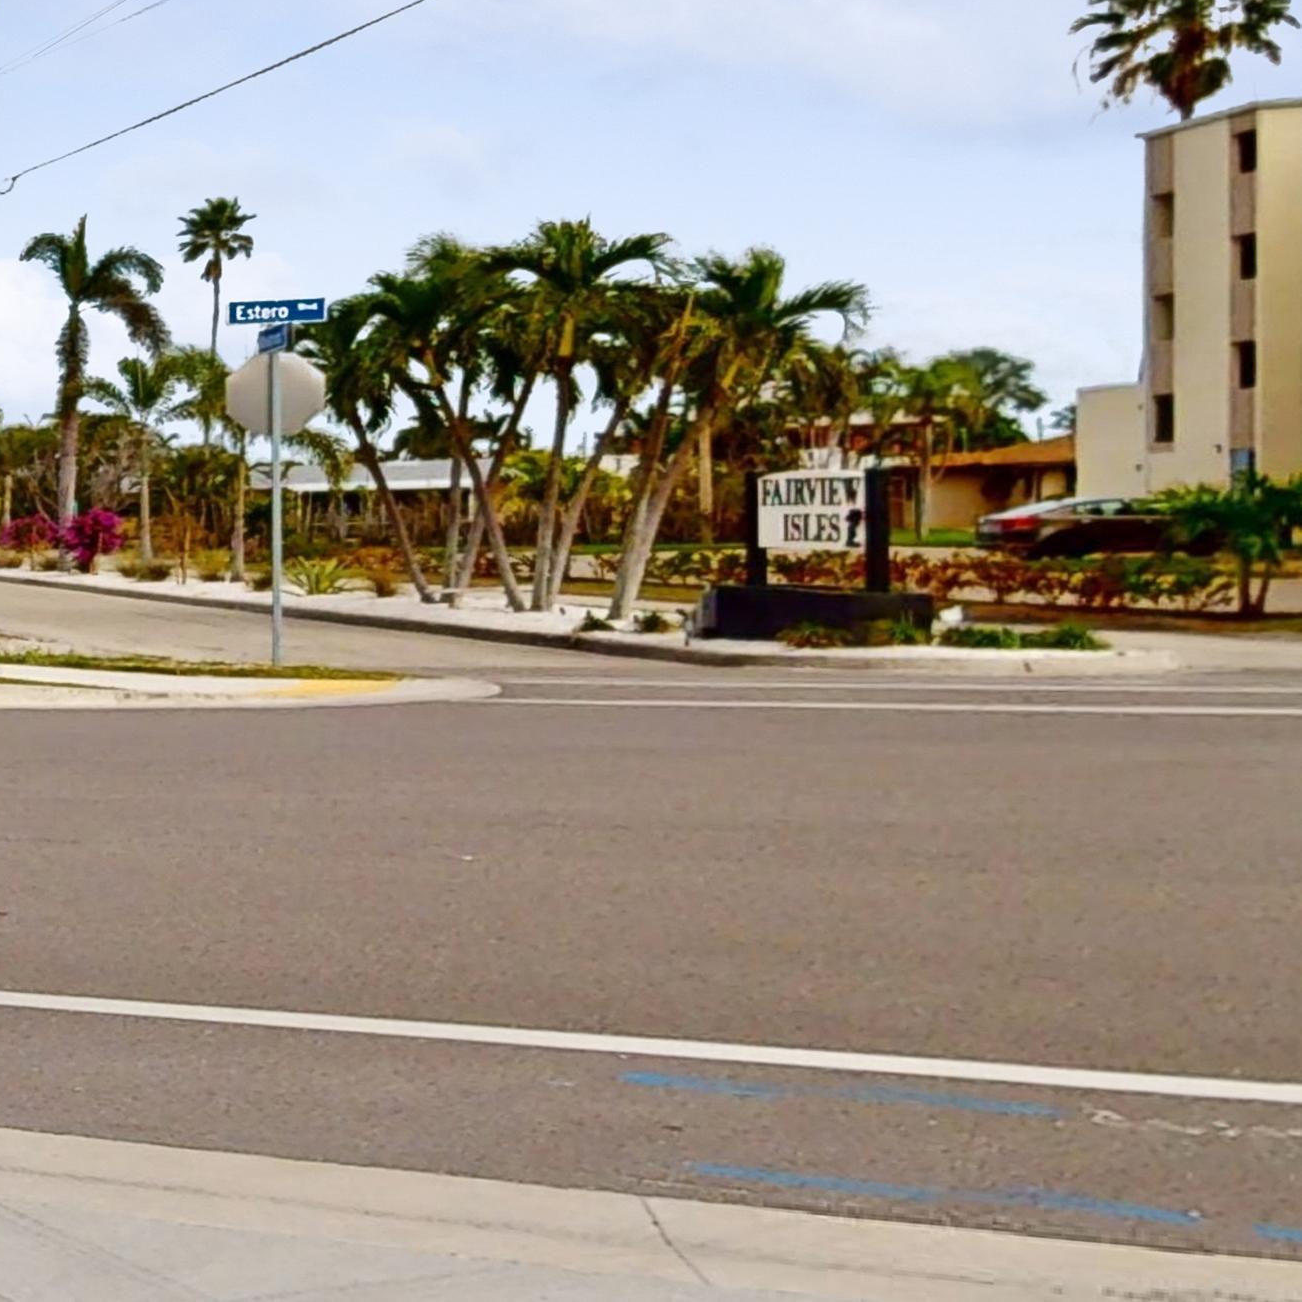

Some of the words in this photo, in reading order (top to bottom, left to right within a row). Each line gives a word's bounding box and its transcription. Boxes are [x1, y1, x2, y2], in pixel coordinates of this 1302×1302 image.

[236, 305, 289, 320] Estero
[762, 478, 861, 506] FAIRVIEW
[784, 513, 841, 542] ISLES
